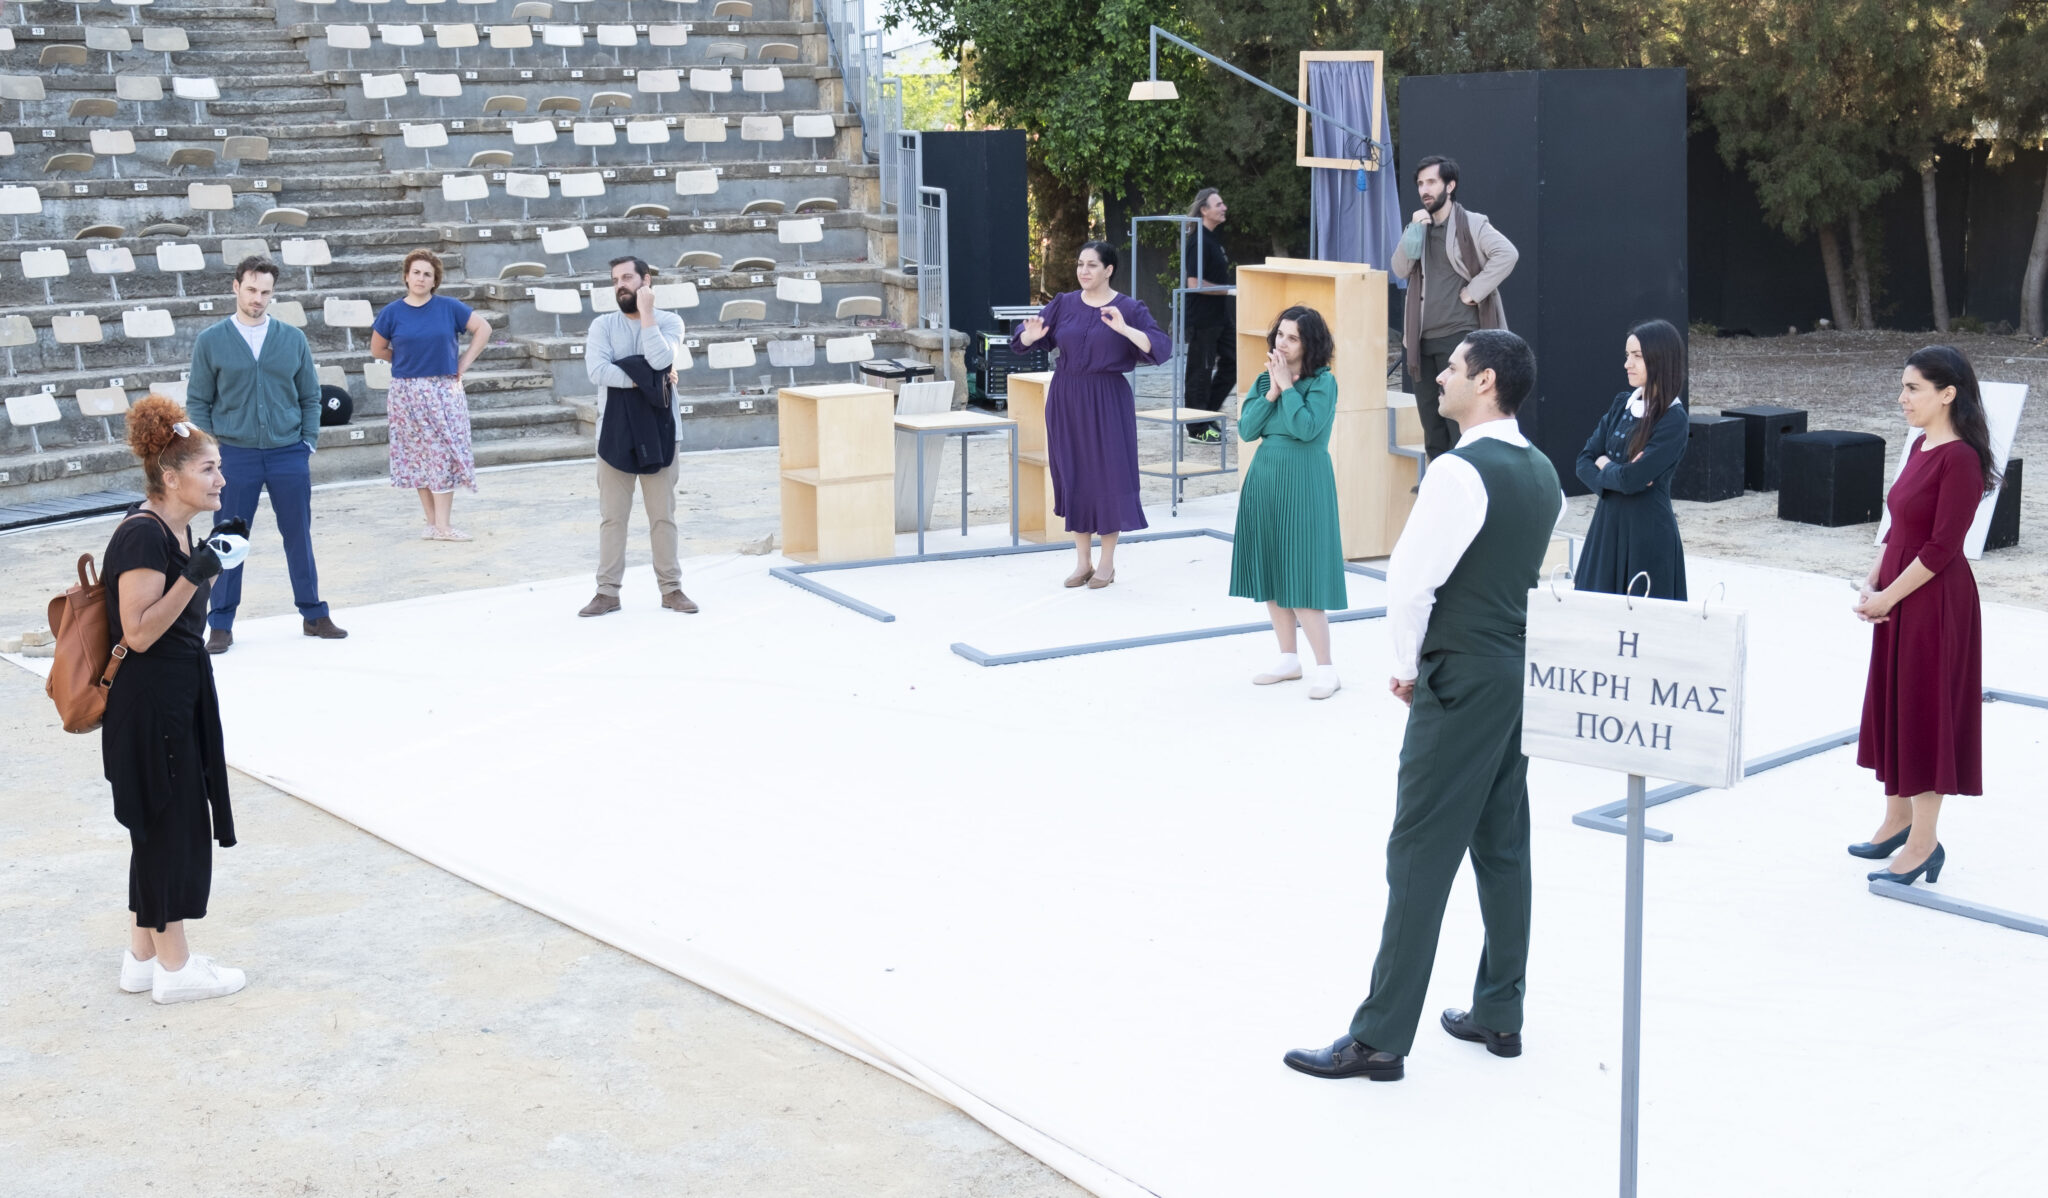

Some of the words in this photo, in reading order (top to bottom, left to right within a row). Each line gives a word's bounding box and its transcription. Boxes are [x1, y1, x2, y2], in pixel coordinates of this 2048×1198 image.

[1617, 630, 1639, 658] Η
[1529, 662, 1630, 701] ΜΙΚΡΗ
[1650, 678, 1727, 715] ΜΑΣ
[1575, 711, 1673, 750] ΠΟΛΗ
